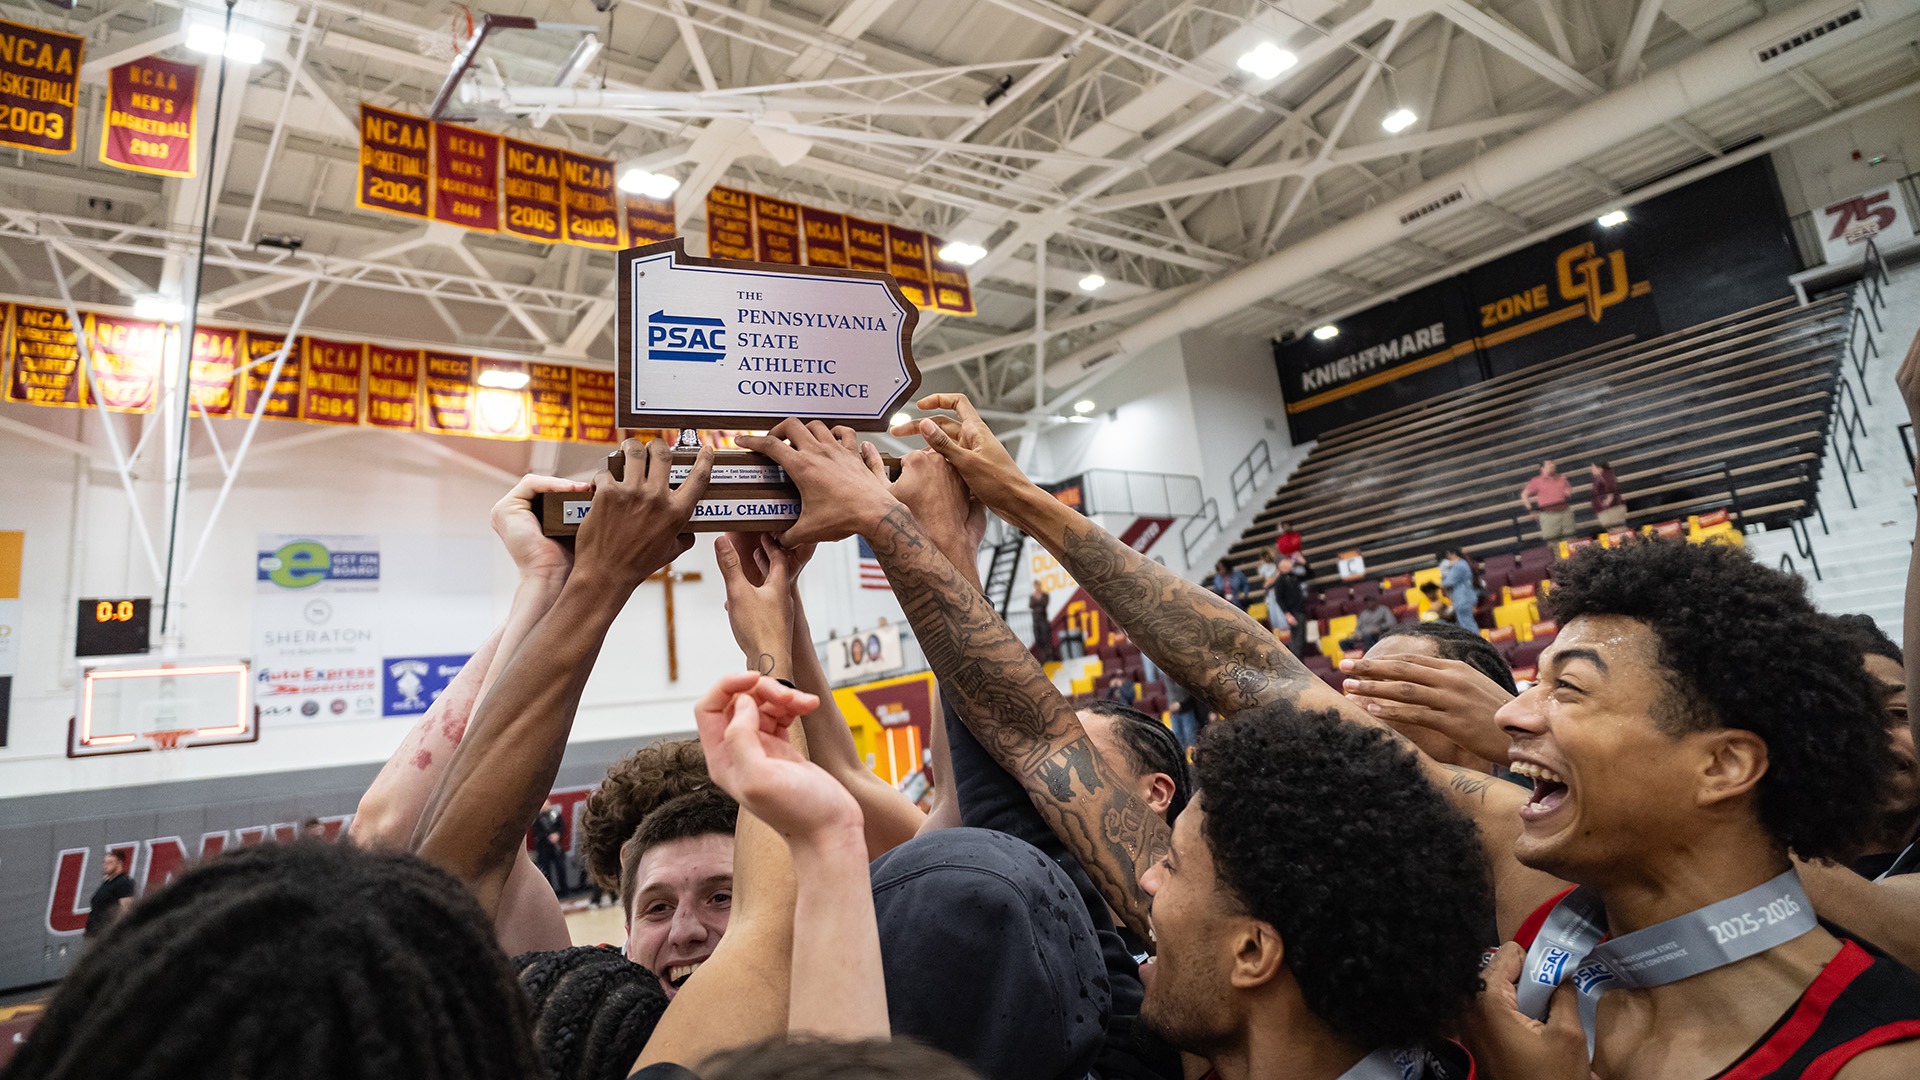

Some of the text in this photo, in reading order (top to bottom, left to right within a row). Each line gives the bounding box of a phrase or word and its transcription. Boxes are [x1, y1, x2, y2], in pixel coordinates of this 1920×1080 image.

[0, 33, 73, 75] NCAA
[129, 65, 177, 91] NCAA
[131, 92, 174, 115] MEN'S
[0, 105, 64, 139] 2003
[110, 110, 190, 139] BASKETBALL
[366, 115, 426, 149] NCAA
[448, 135, 485, 159] NCAA
[508, 147, 560, 178] NCAA
[564, 160, 612, 189] NCAA
[369, 176, 421, 206] 2004
[711, 190, 747, 208] NCAA
[509, 204, 557, 232] 2005
[760, 200, 796, 220] NCAA
[1825, 190, 1897, 241] 75
[806, 219, 843, 241] NCAA
[851, 228, 882, 247] PSAC
[892, 237, 922, 260] NCAA
[736, 290, 763, 302] THE
[1480, 284, 1549, 328] ZONE
[22, 309, 74, 330] NCAA
[737, 308, 888, 332] PENNSYLVANIA
[193, 331, 234, 359] CAA
[648, 325, 726, 351] PSAC
[737, 332, 799, 350] STATE
[312, 347, 358, 370] NCAA
[372, 352, 415, 376] NCAA
[430, 357, 470, 376] MECC
[737, 356, 837, 374] ATHLETIC
[1302, 322, 1446, 393] KNIGHTMARE
[532, 362, 568, 380] NCAA
[577, 368, 614, 388] NCAA
[737, 380, 869, 399] CONFERENCE
[694, 503, 801, 516] BALL CHAMPIO
[332, 554, 378, 565] GET ON
[1031, 552, 1060, 574] OU
[332, 565, 379, 578] BOARD!
[96, 600, 135, 623] 0.0
[264, 628, 372, 646] SHERATON
[842, 633, 882, 668] 100
[1707, 894, 1801, 946] 2025-2026
[1538, 947, 1564, 985] PSAC
[1571, 962, 1610, 990] PSAC
